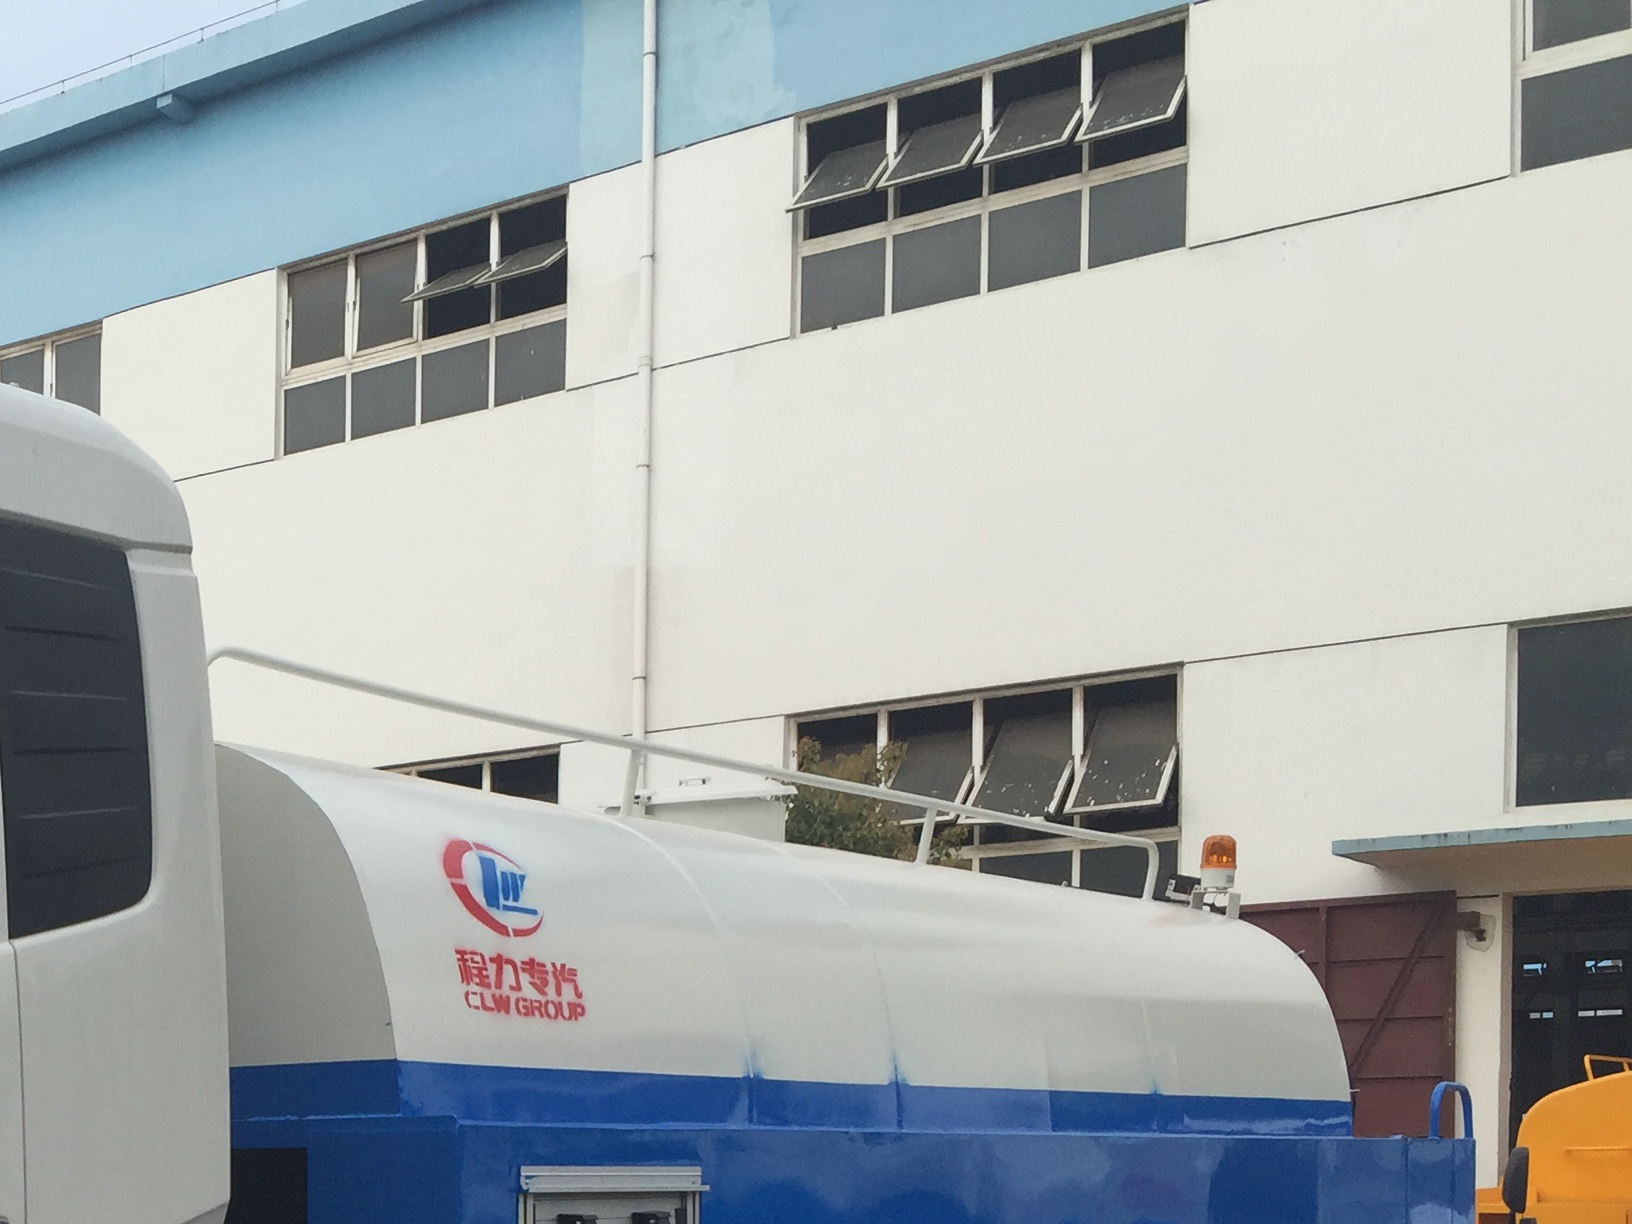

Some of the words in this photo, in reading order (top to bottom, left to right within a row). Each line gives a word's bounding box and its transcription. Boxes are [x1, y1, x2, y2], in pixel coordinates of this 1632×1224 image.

[455, 948, 584, 1000] 程力专汽
[464, 990, 511, 1015] CLW
[514, 997, 586, 1021] GROUP
